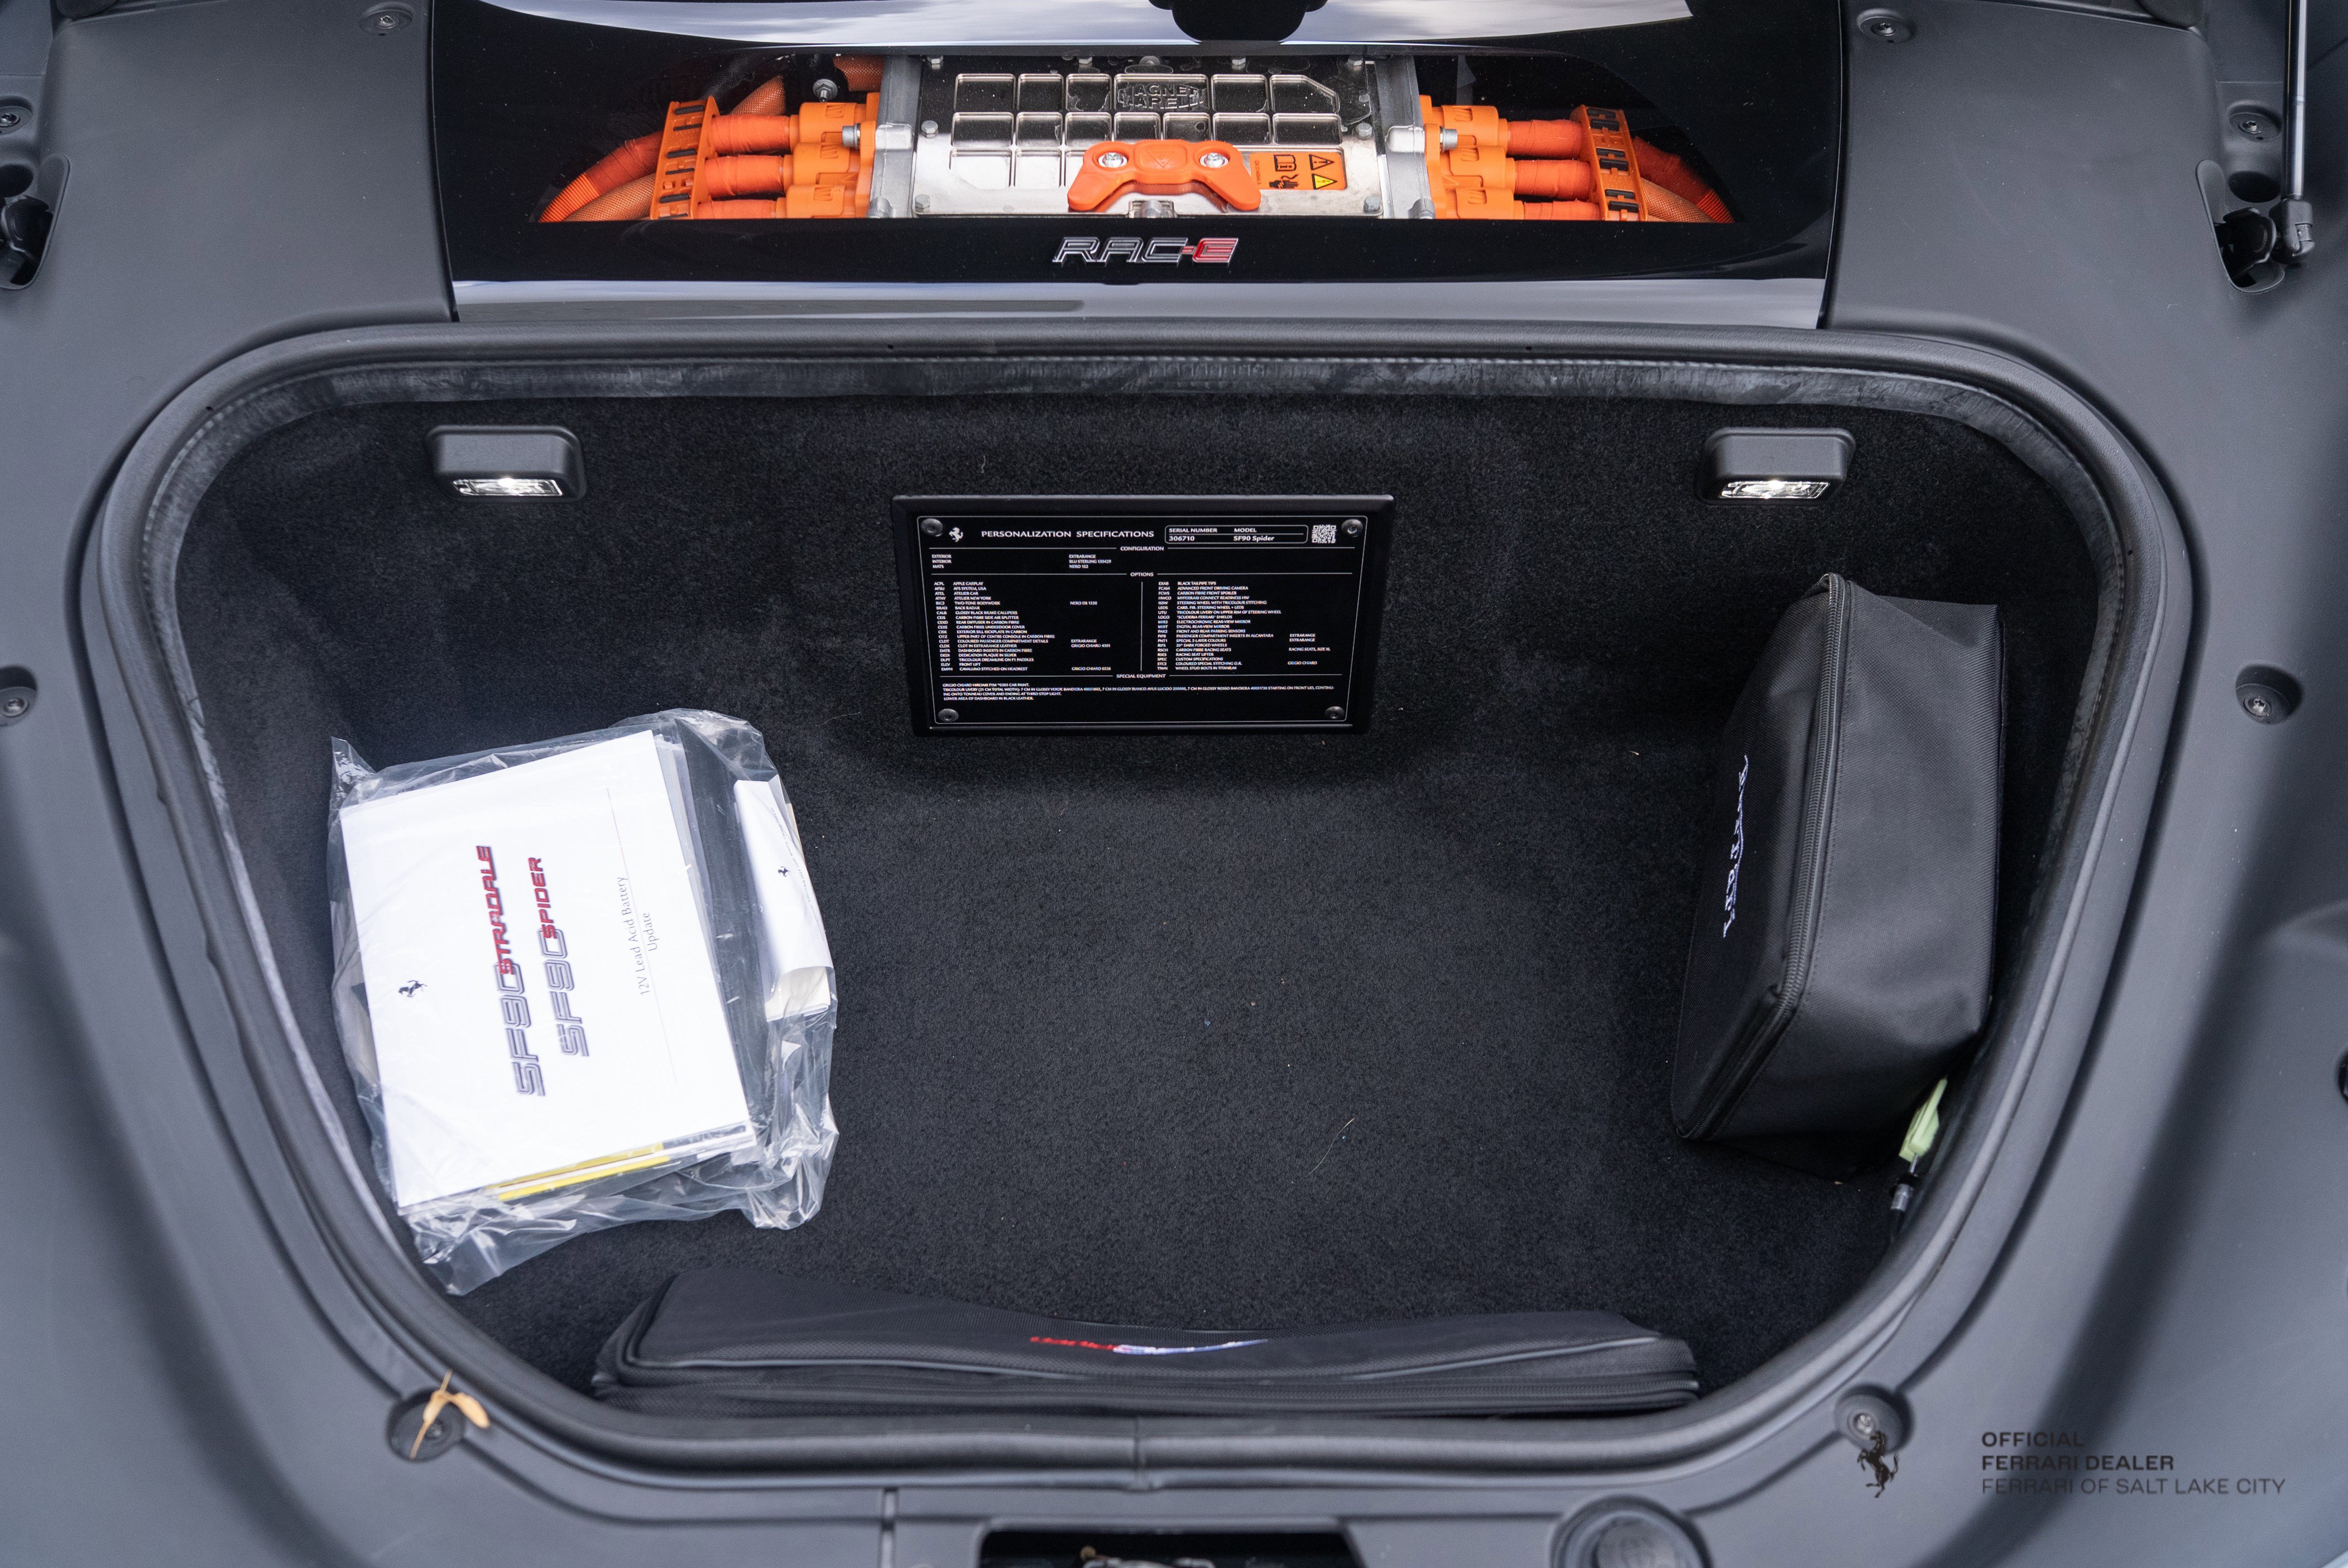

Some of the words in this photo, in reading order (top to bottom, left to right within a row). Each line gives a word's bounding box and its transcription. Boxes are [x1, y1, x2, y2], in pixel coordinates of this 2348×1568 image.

[1052, 237, 1239, 267] RAC-E
[476, 845, 514, 976] STRADALE
[529, 857, 557, 940] SPIDER
[616, 876, 633, 915] Battery
[625, 918, 639, 942] Acid
[641, 912, 659, 952] Update
[630, 946, 646, 973] Lead
[536, 927, 590, 1057] SF90
[637, 975, 651, 995] 12V
[493, 962, 545, 1097] SF90
